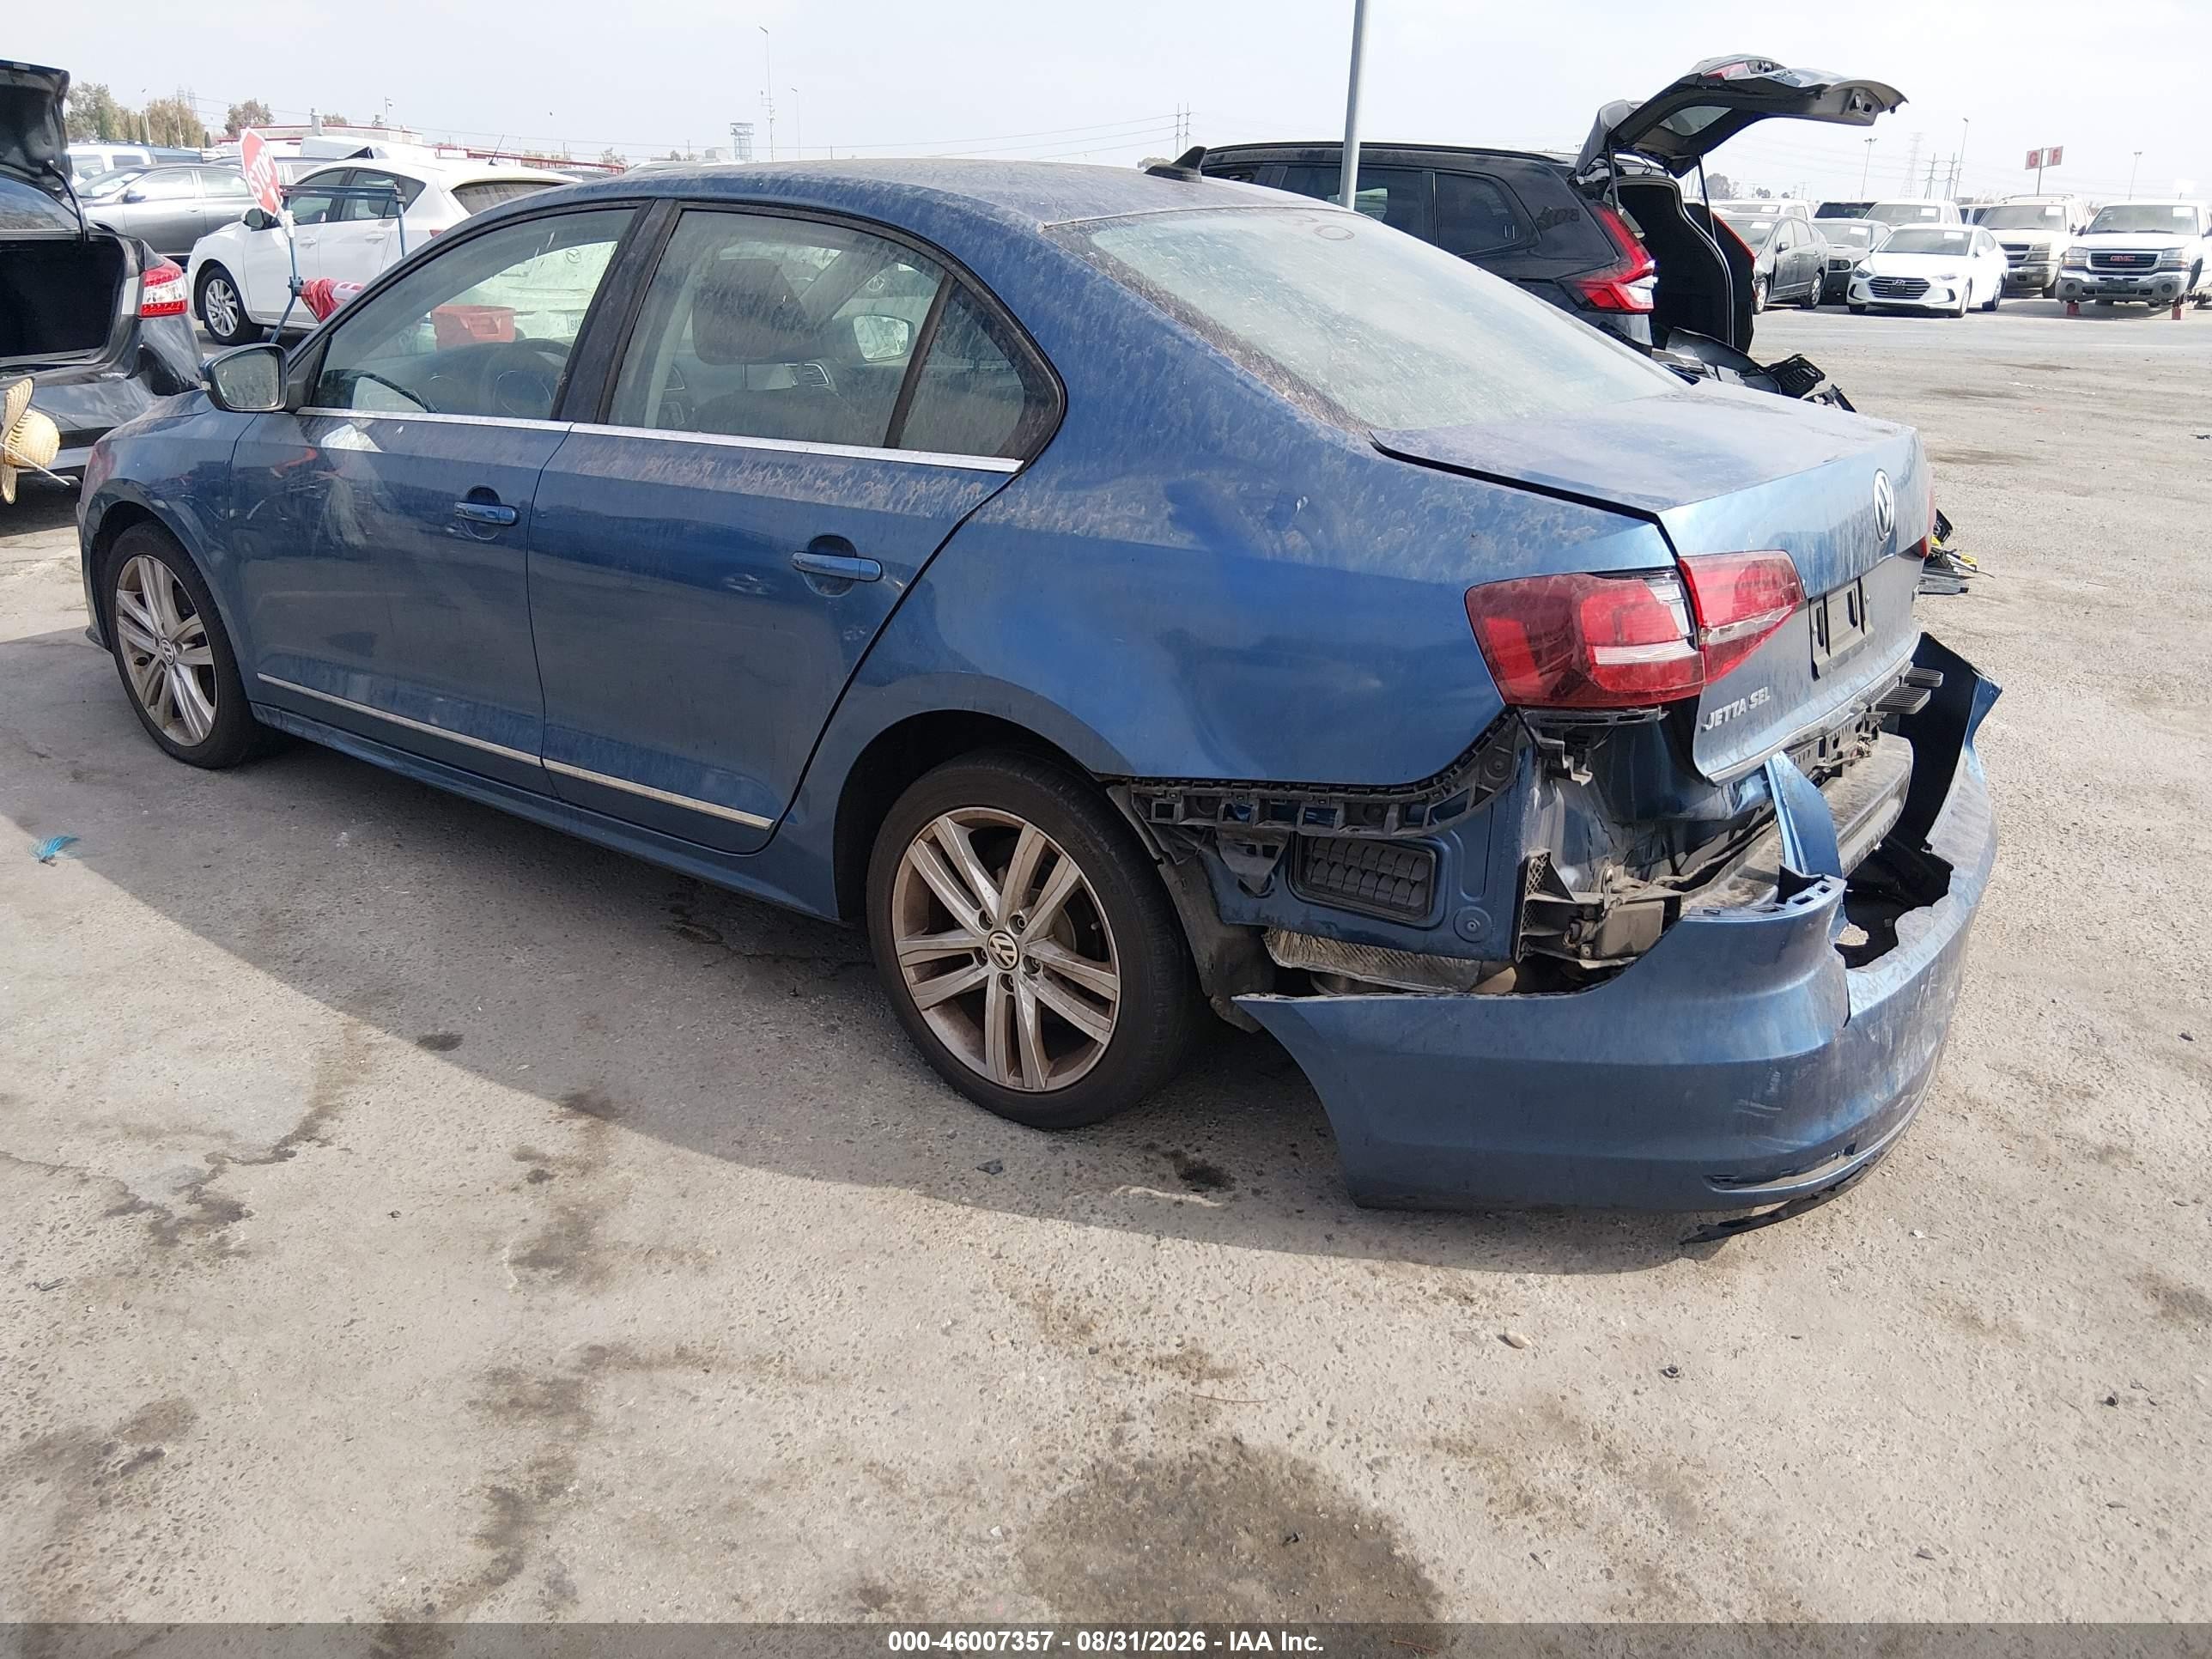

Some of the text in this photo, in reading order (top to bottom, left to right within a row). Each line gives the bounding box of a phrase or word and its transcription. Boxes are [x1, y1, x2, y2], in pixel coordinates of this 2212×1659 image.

[247, 143, 274, 200] STOP
[2028, 151, 2038, 167] G
[1702, 687, 1771, 731] JETTA SEL
